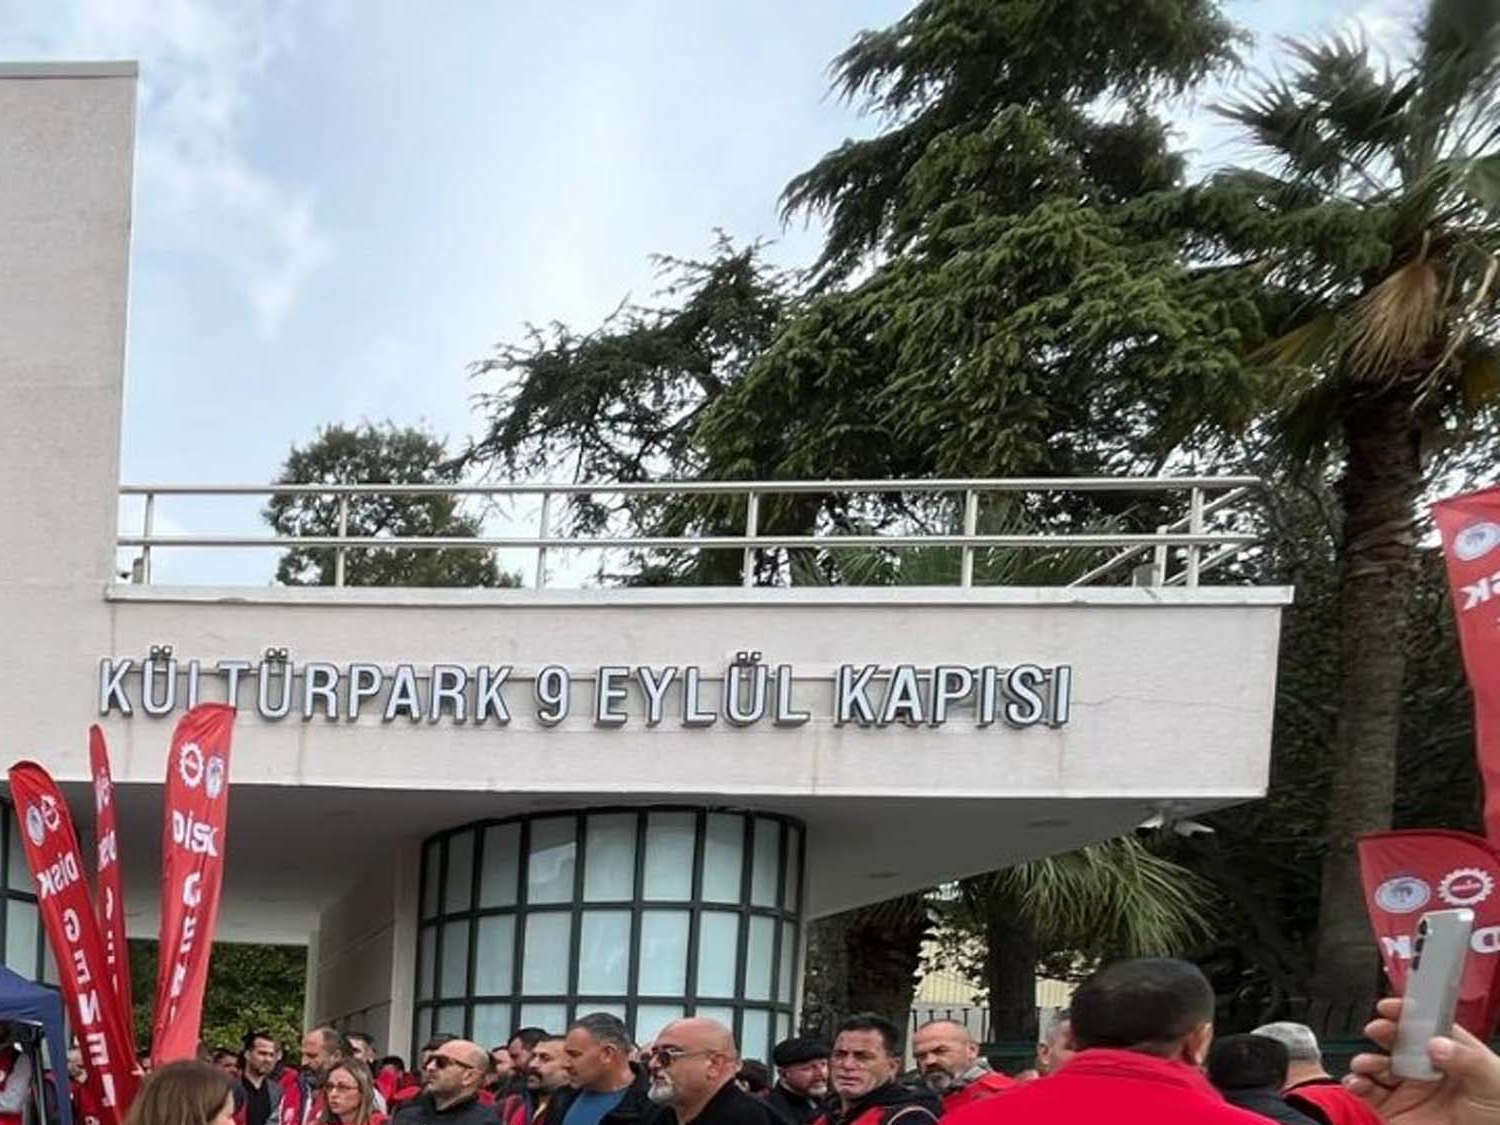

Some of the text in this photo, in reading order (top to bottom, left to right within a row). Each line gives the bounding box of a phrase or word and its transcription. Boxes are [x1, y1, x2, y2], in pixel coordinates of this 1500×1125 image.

[98, 645, 1072, 728] KÜLTÜRPARK 9 EYLÜL KAPISI
